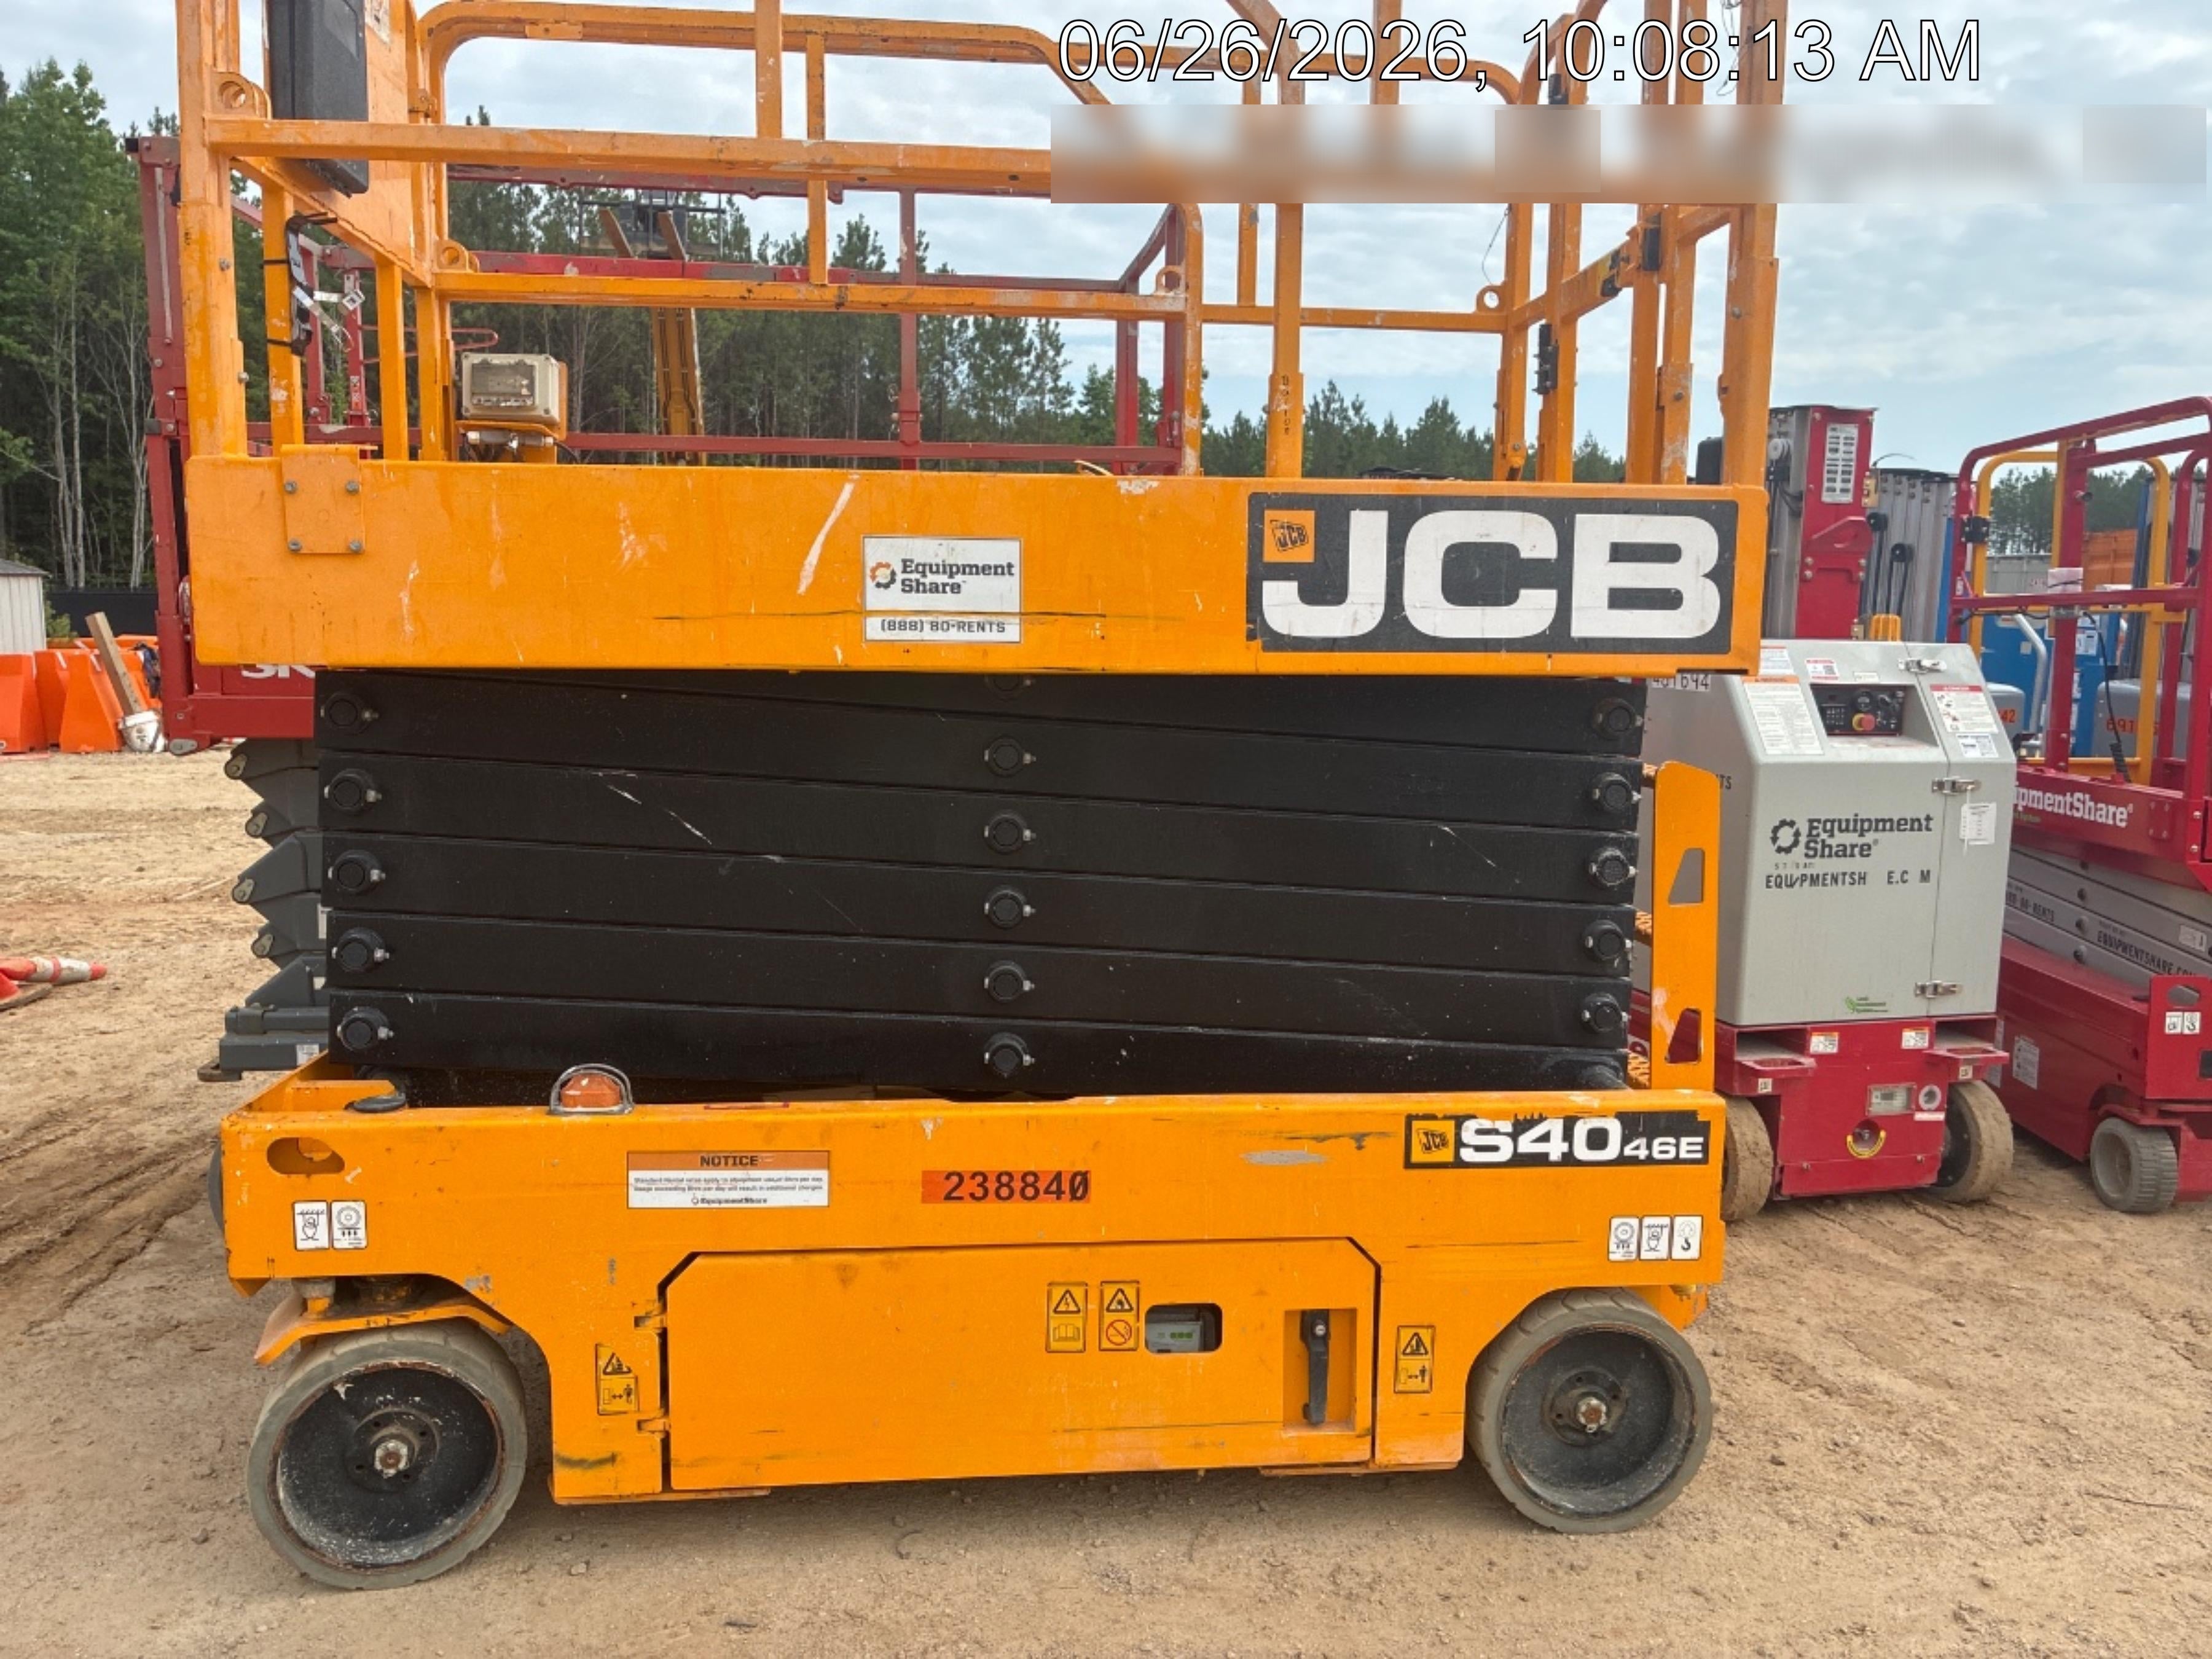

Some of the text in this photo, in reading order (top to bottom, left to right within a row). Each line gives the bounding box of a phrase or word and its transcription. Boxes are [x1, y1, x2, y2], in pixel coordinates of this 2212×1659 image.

[901, 558, 1014, 579] Equipment
[1261, 509, 1721, 639] JCB
[900, 578, 962, 594] Share
[880, 619, 925, 633] (888)
[1806, 813, 1934, 838] Equipment
[1804, 838, 1872, 859] Share
[699, 1155, 759, 1167] NOTICE
[943, 1169, 1089, 1201] 238840
